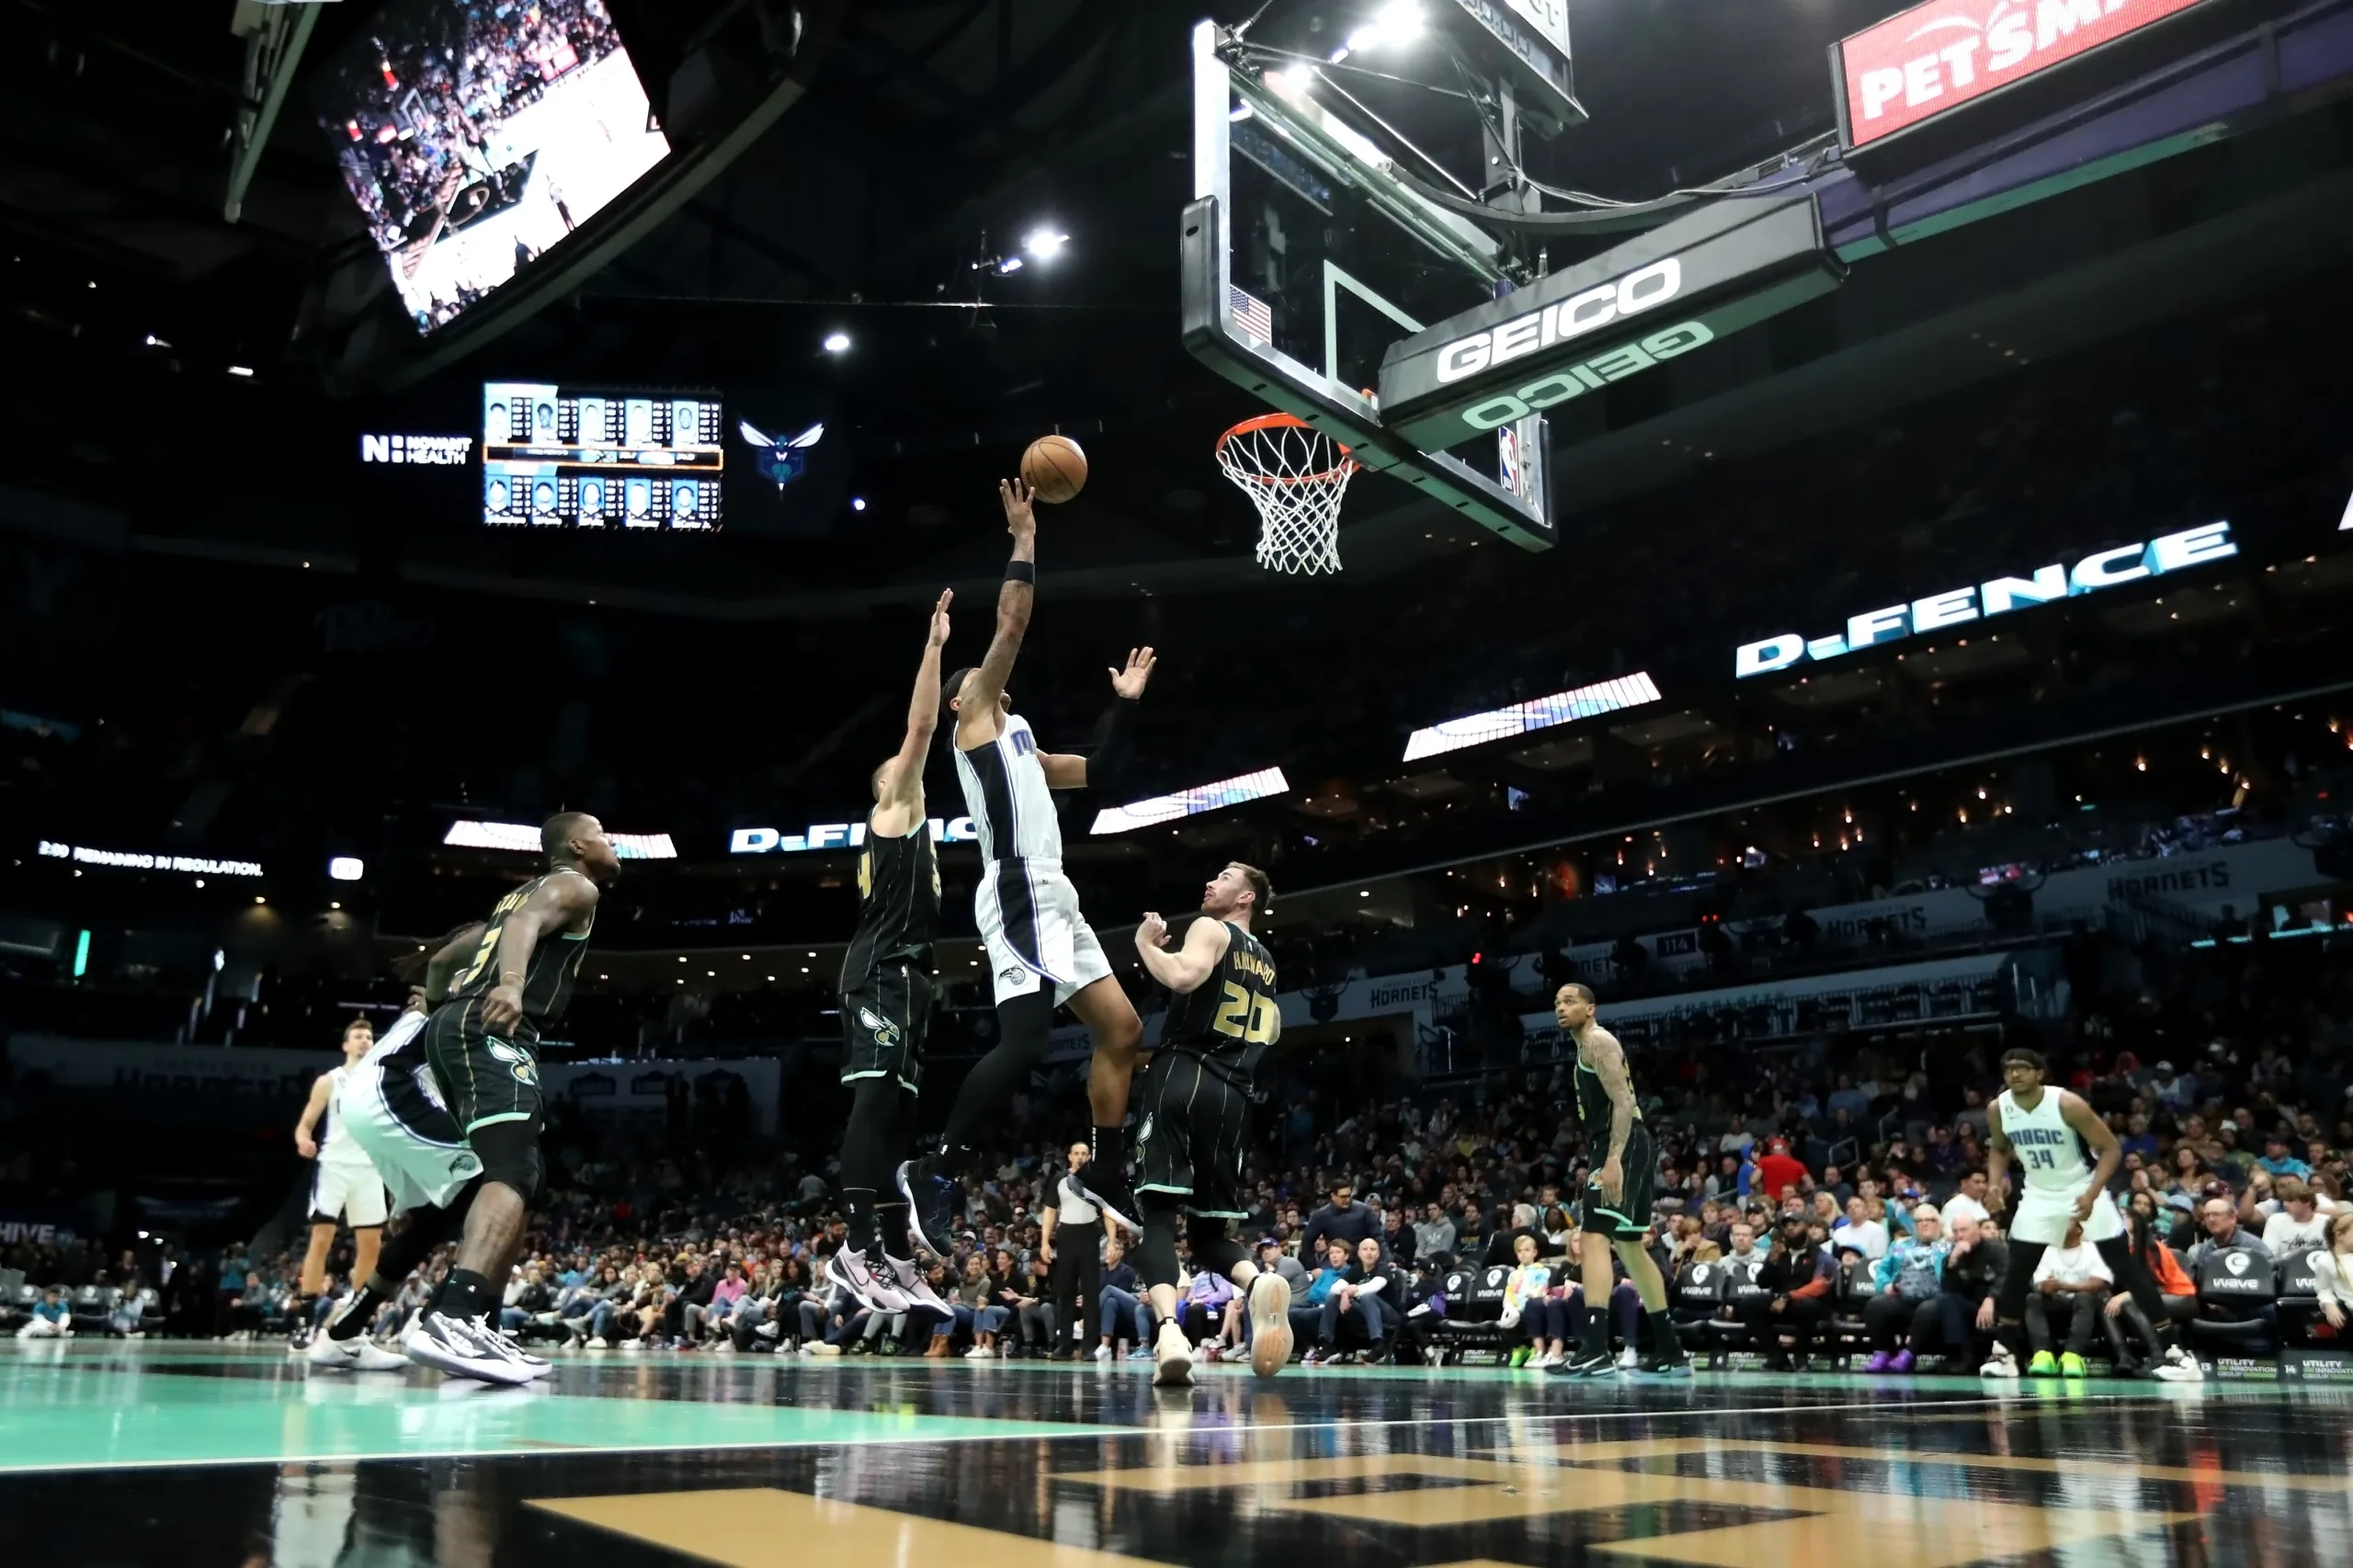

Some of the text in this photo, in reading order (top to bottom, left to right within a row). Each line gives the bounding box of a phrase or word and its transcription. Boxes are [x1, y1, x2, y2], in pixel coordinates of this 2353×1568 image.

[1437, 257, 1681, 383] GEICO
[1461, 321, 1714, 430] GEICO
[405, 436, 472, 451] NOVANT
[405, 449, 466, 464] HEALTH
[1735, 520, 2239, 679] D-FENCE
[74, 846, 154, 869] REMAINING
[155, 856, 173, 869] IN
[1828, 906, 1927, 937] HORETS
[1663, 936, 1689, 954] 114
[1369, 982, 1438, 1009] HORNETS
[1213, 979, 1278, 1045] 20
[2007, 1128, 2065, 1146] MAGIC
[2026, 1148, 2055, 1170] 34
[2217, 1358, 2256, 1367] UTILITY
[2284, 1364, 2296, 1375] 14
[2302, 1359, 2343, 1368] UTILITY
